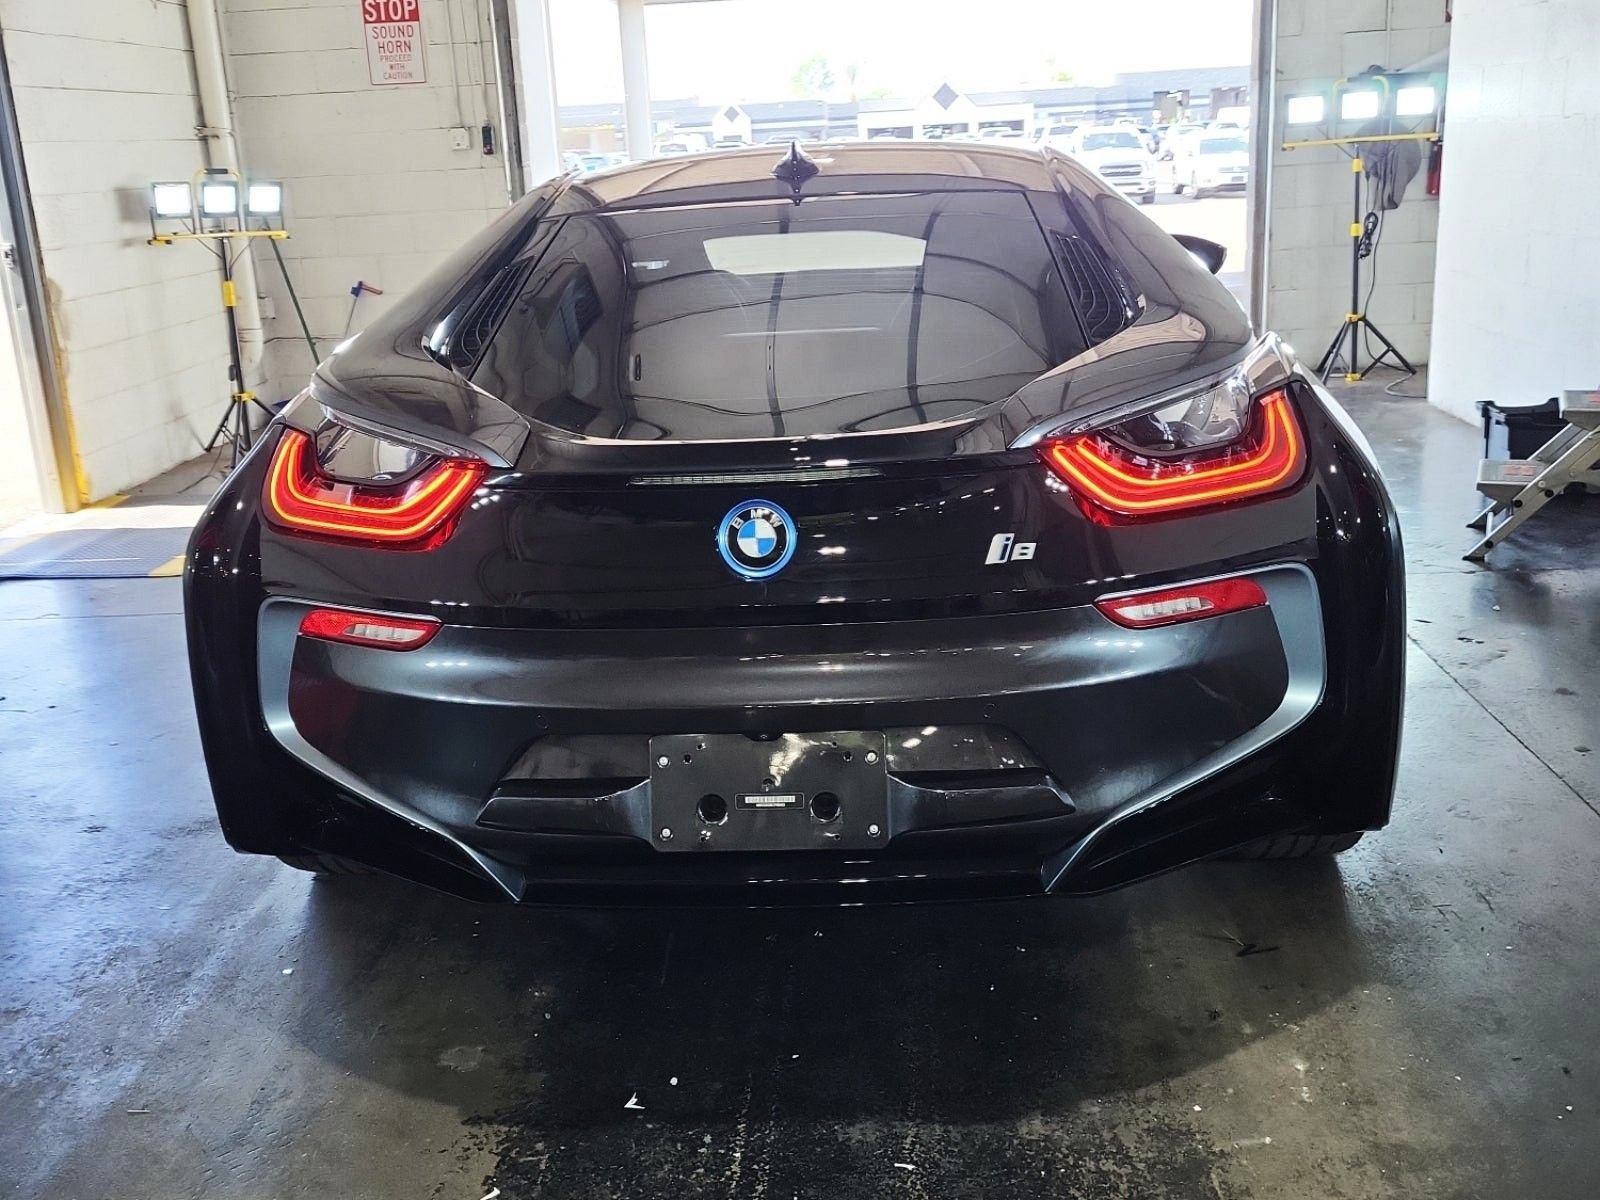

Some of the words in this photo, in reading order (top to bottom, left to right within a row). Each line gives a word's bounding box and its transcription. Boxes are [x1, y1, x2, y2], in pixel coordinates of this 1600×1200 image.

[364, 0, 417, 21] STOP
[372, 25, 414, 39] SOUND
[378, 40, 411, 54] HORN
[380, 54, 412, 62] PROCEED
[389, 63, 405, 71] WITH
[384, 72, 413, 80] CAUTION
[731, 508, 783, 529] BMW
[984, 532, 1037, 565] i8
